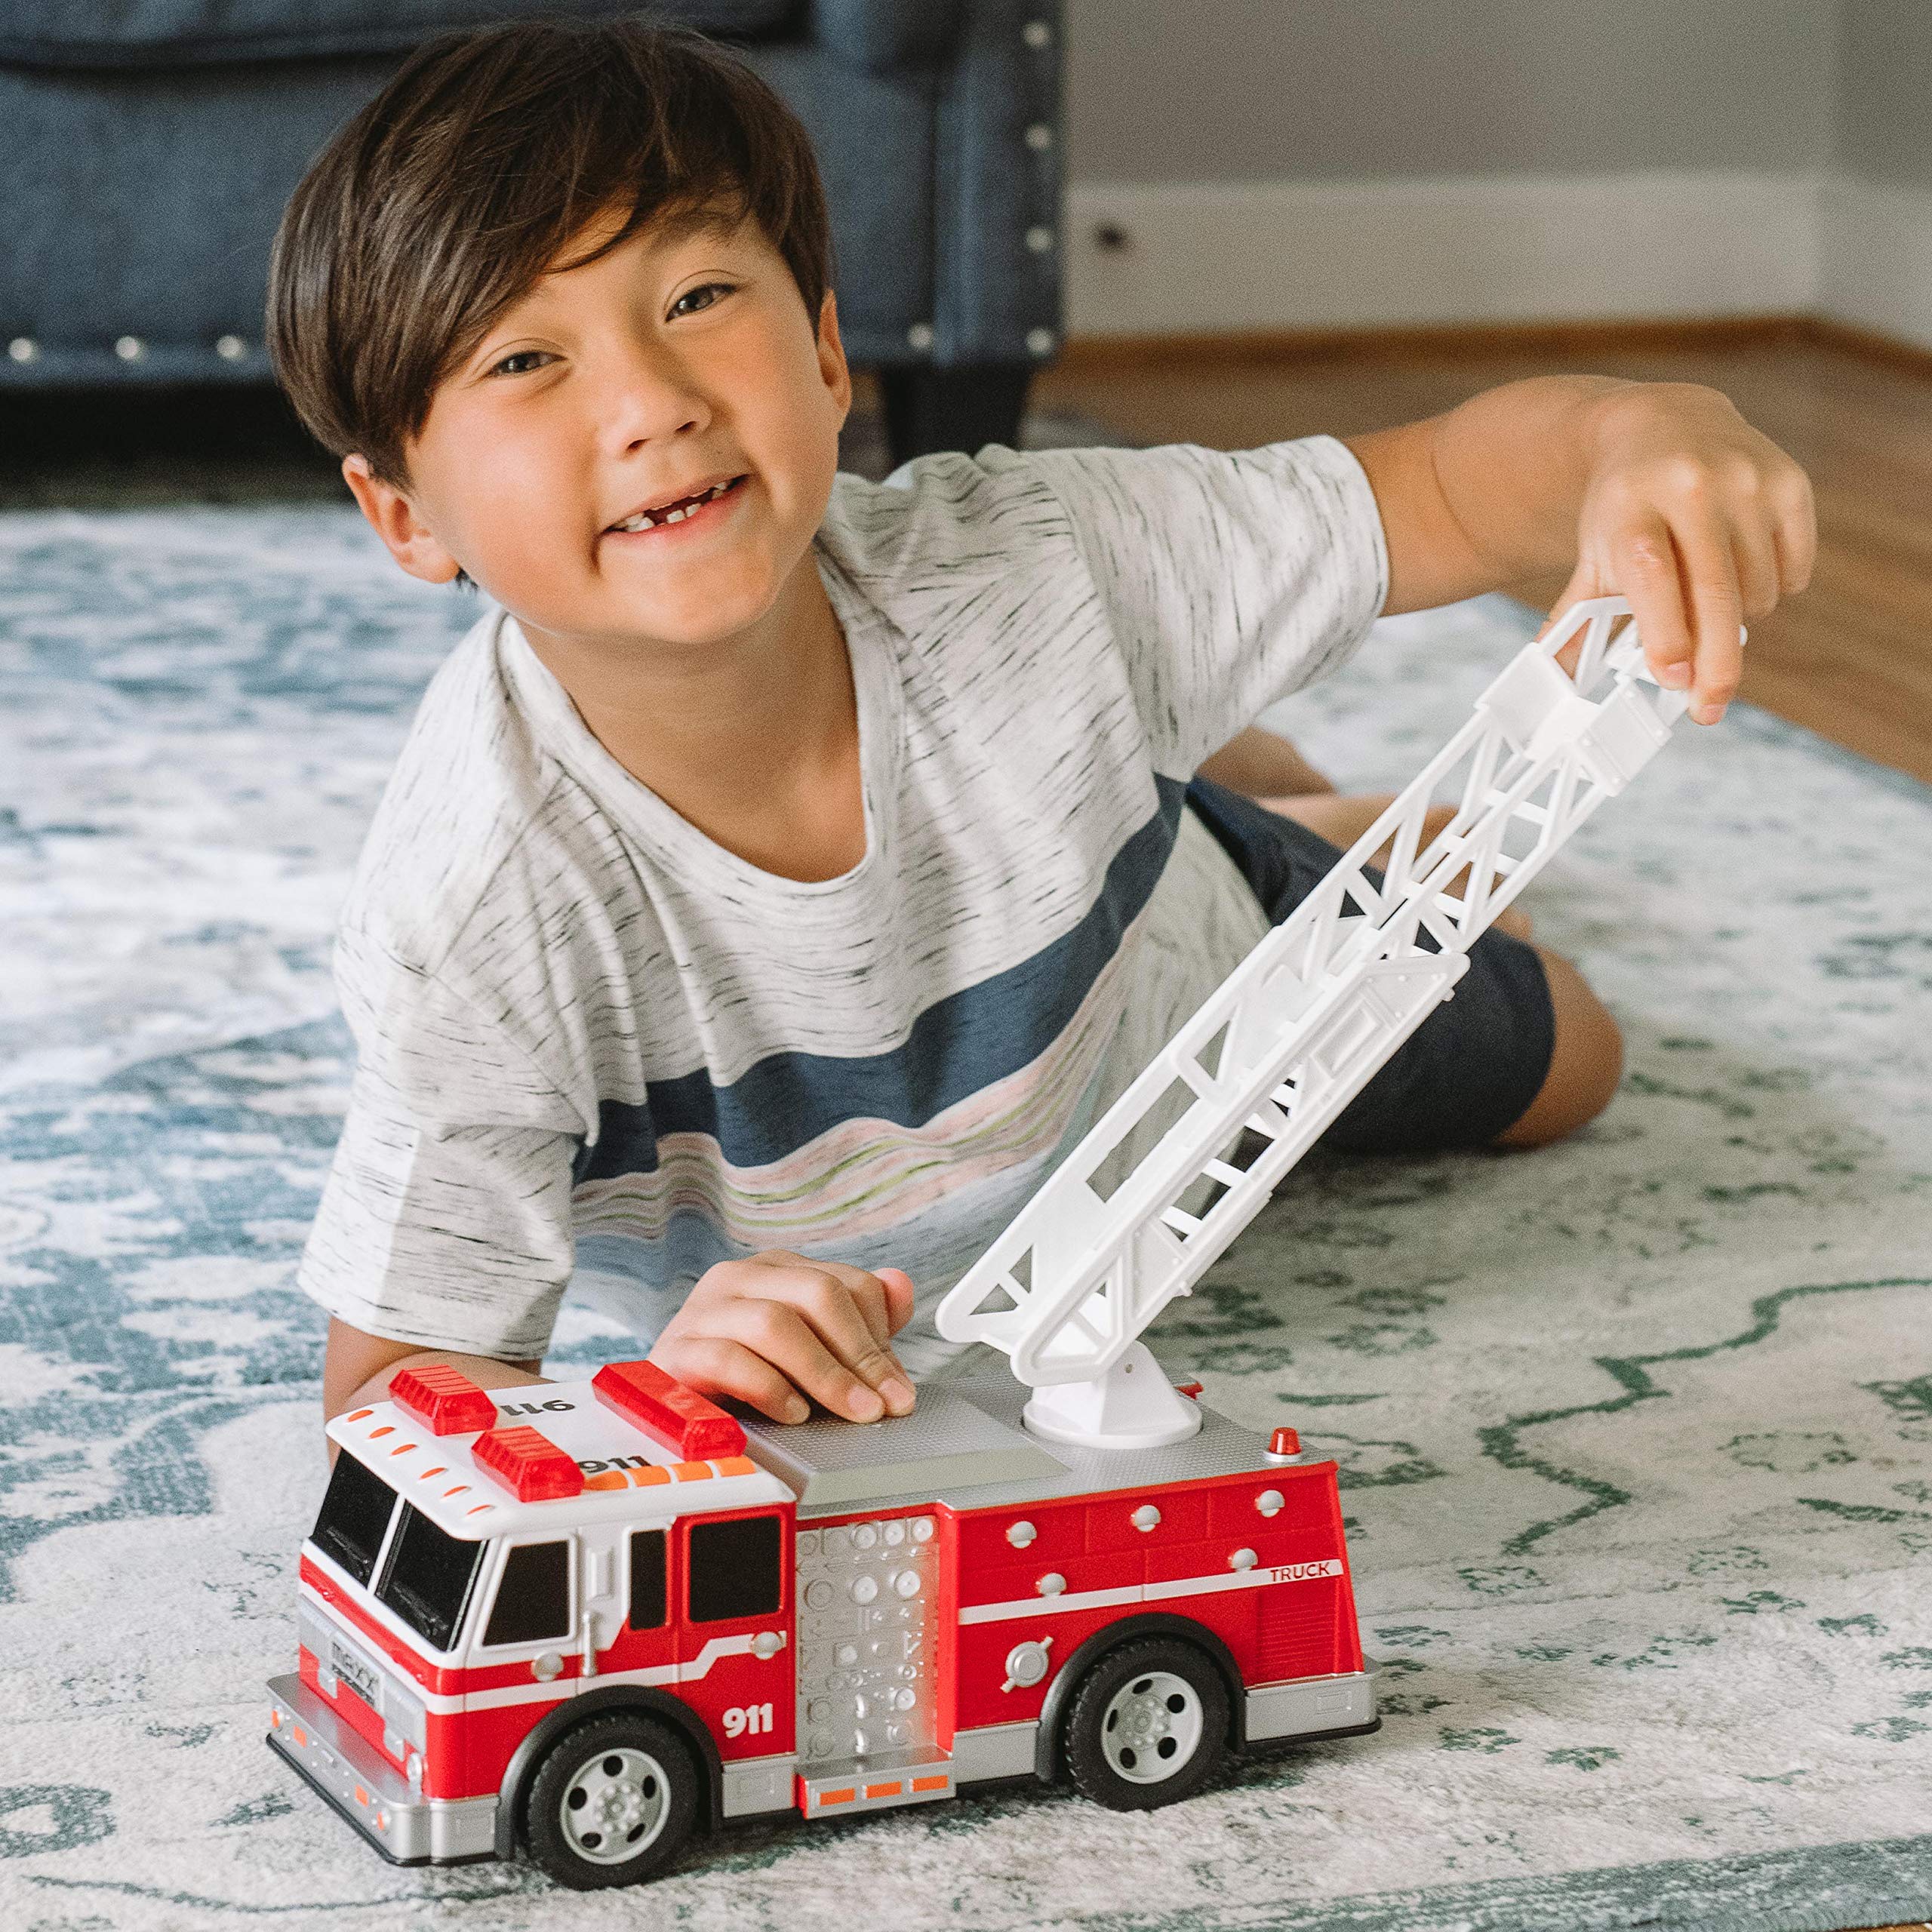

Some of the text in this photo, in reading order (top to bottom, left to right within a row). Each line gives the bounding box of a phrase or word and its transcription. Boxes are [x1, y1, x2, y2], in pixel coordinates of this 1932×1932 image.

[500, 1399, 576, 1417] 911
[577, 1455, 652, 1473] 911
[1269, 1561, 1331, 1583] TRUCK
[721, 1702, 774, 1739] 911
